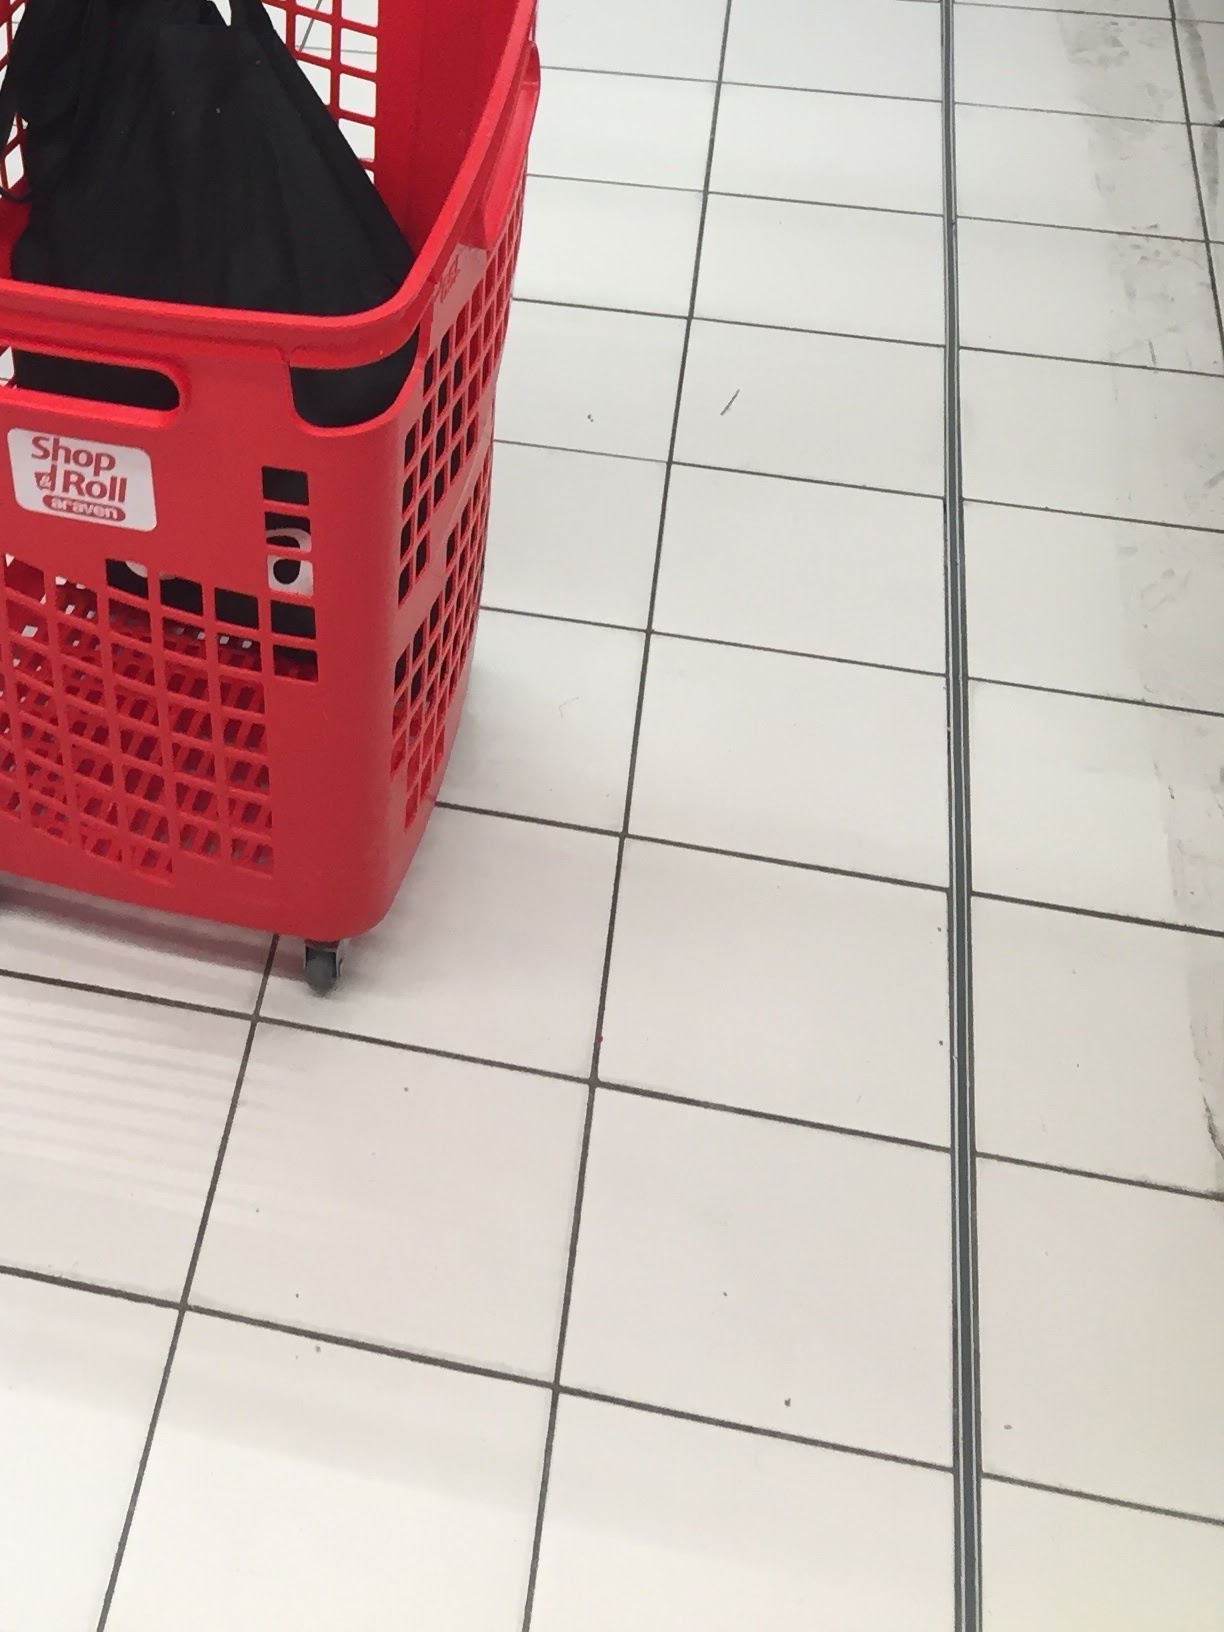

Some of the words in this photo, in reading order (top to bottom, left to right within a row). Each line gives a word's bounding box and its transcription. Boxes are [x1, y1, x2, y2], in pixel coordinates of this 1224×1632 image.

[31, 435, 116, 477] Shop
[62, 469, 128, 503] Roll
[51, 497, 118, 520] araven
